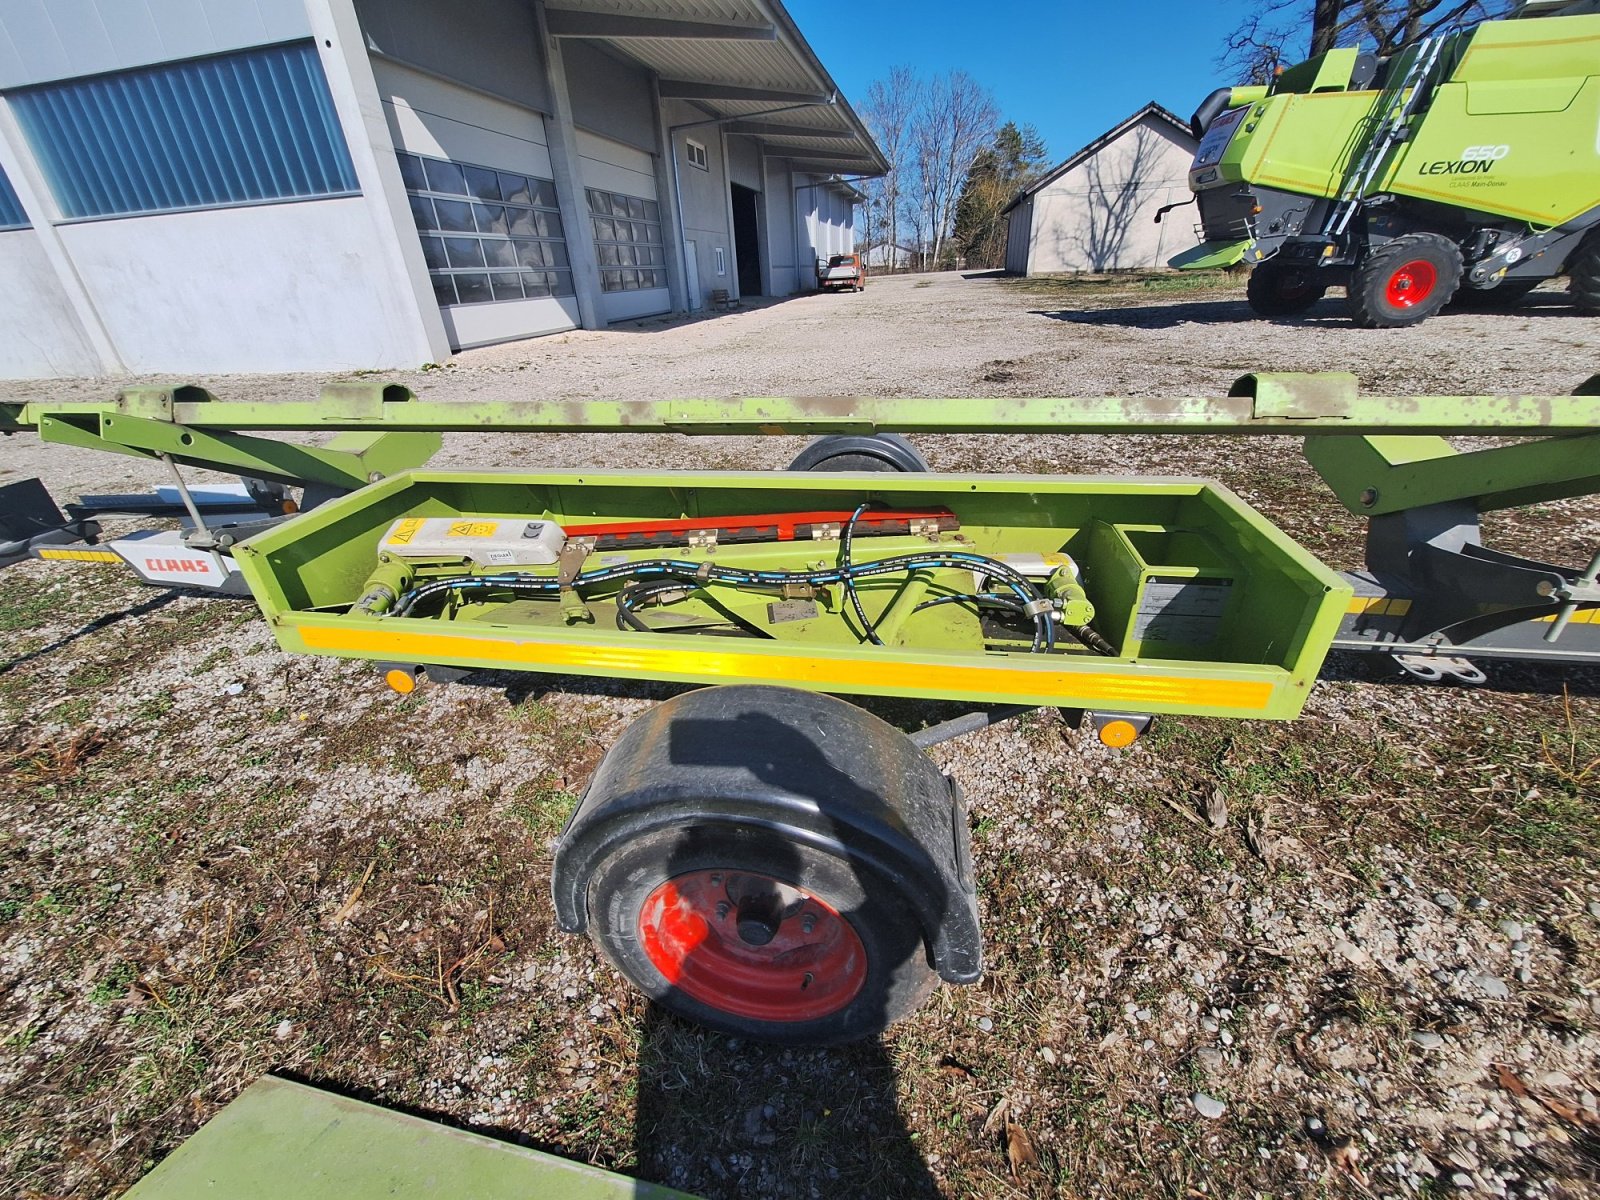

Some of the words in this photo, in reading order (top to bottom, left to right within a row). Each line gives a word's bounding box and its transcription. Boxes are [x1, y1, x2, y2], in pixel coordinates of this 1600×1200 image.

[1461, 144, 1510, 161] 650
[1418, 159, 1495, 175] LEXION
[1449, 181, 1470, 189] CLAAS
[1470, 180, 1507, 188] Main-Donau
[1508, 250, 1520, 261] 25
[145, 558, 209, 573] CLAAS
